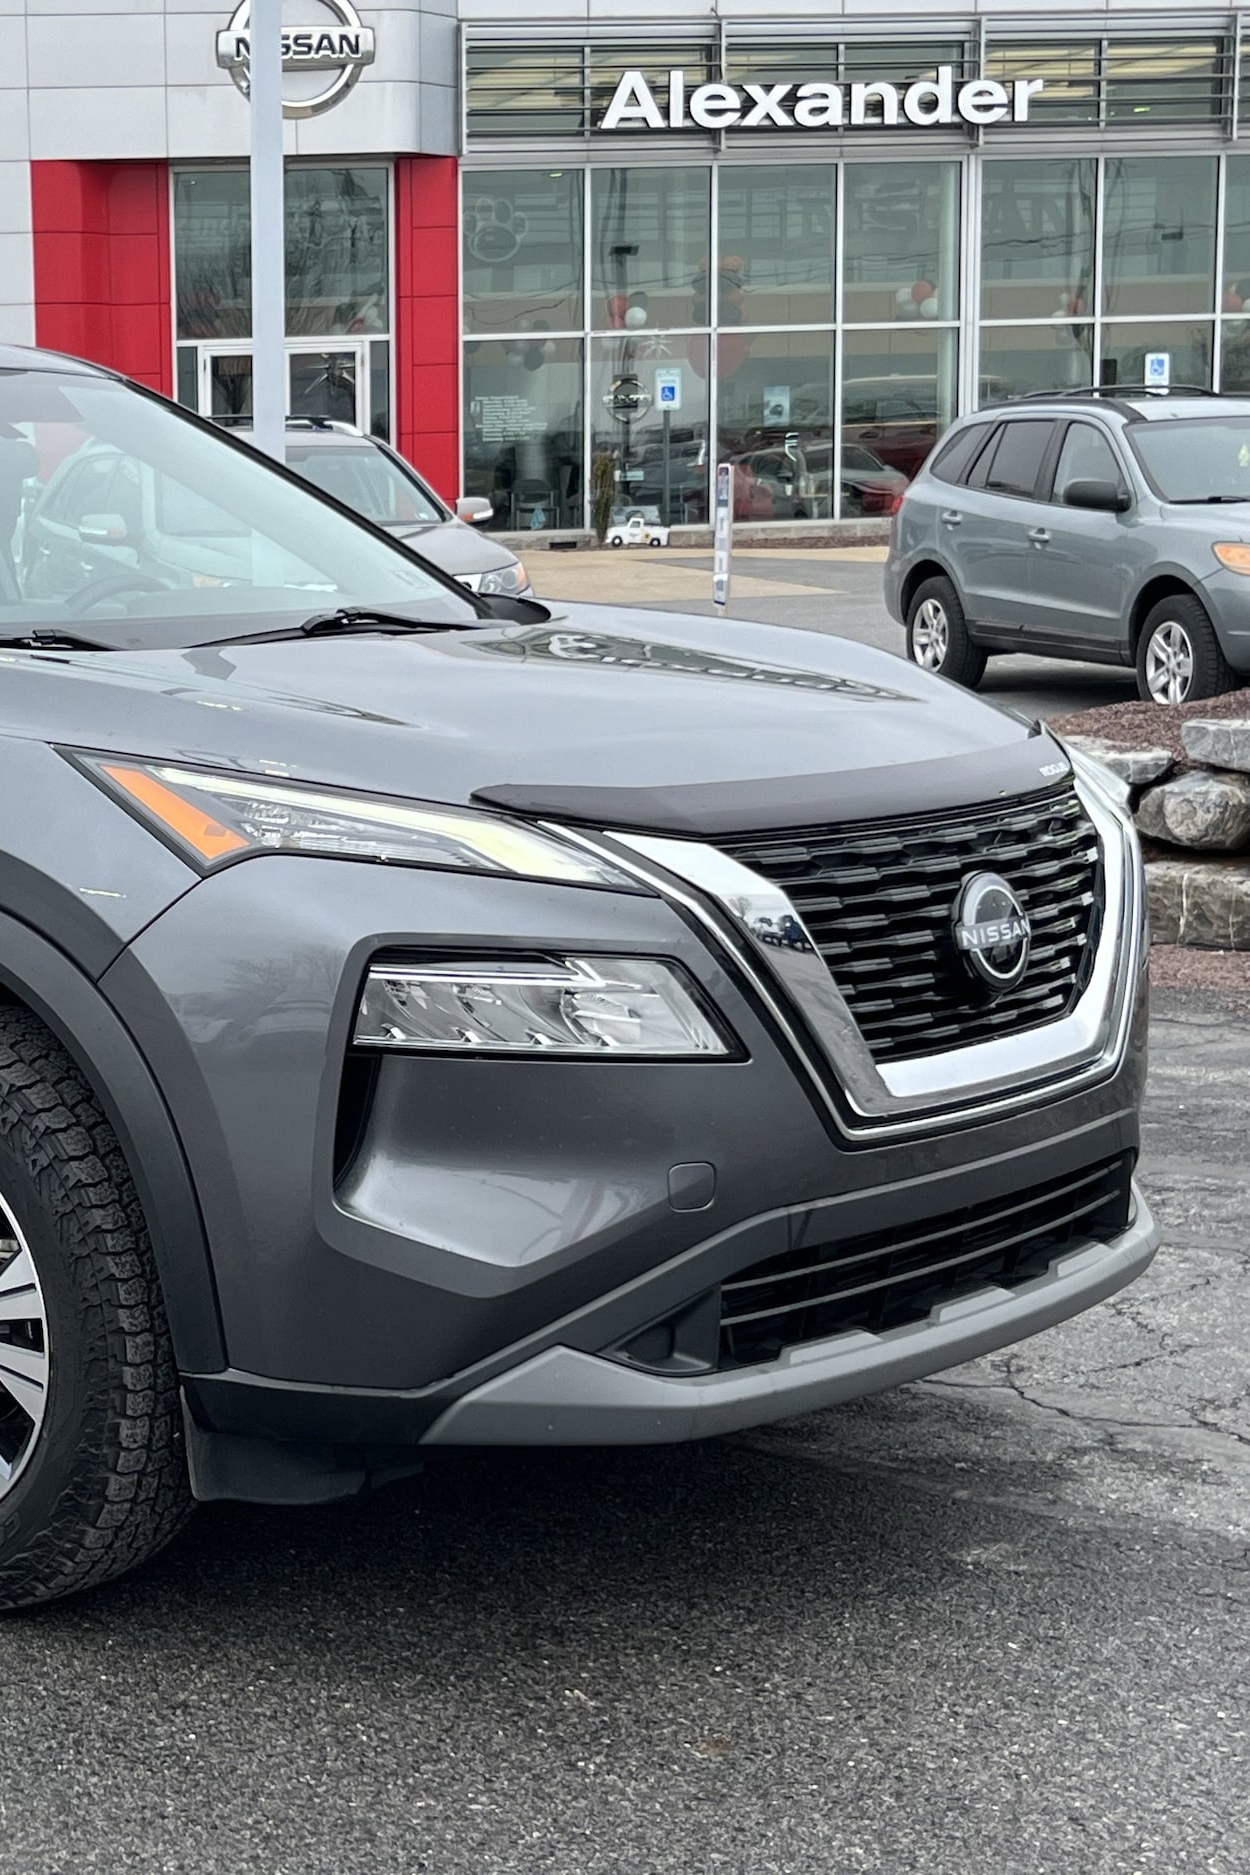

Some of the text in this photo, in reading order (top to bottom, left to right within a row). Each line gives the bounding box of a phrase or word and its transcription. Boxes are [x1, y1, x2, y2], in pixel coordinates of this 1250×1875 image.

[235, 33, 361, 58] NSSAN
[599, 66, 1044, 129] Alexander
[961, 919, 1031, 947] NISSAN
